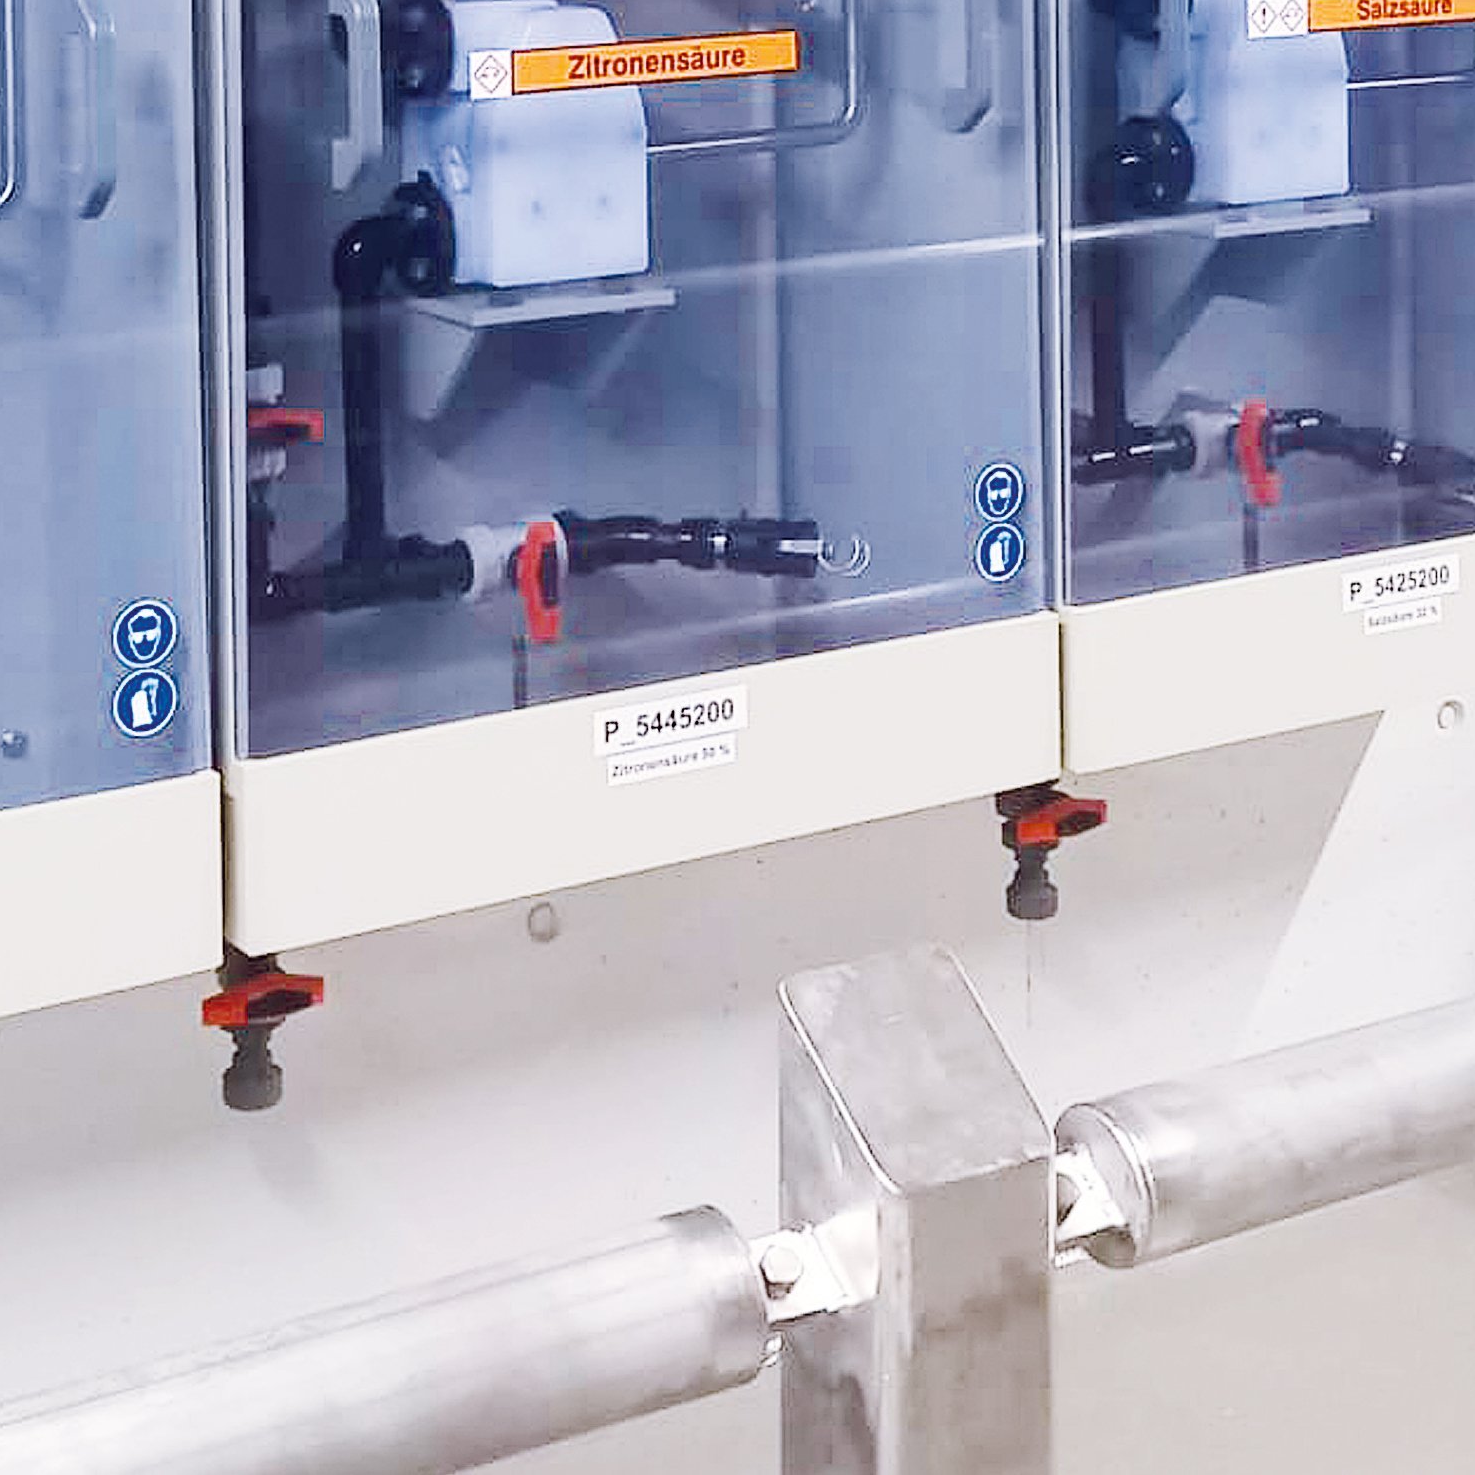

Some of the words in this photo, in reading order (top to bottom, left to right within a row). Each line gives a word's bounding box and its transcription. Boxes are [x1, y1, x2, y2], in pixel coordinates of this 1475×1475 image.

[568, 45, 746, 79] Zitronensäure
[1350, 564, 1451, 605] P_5425200
[605, 698, 735, 747] P_5445200
